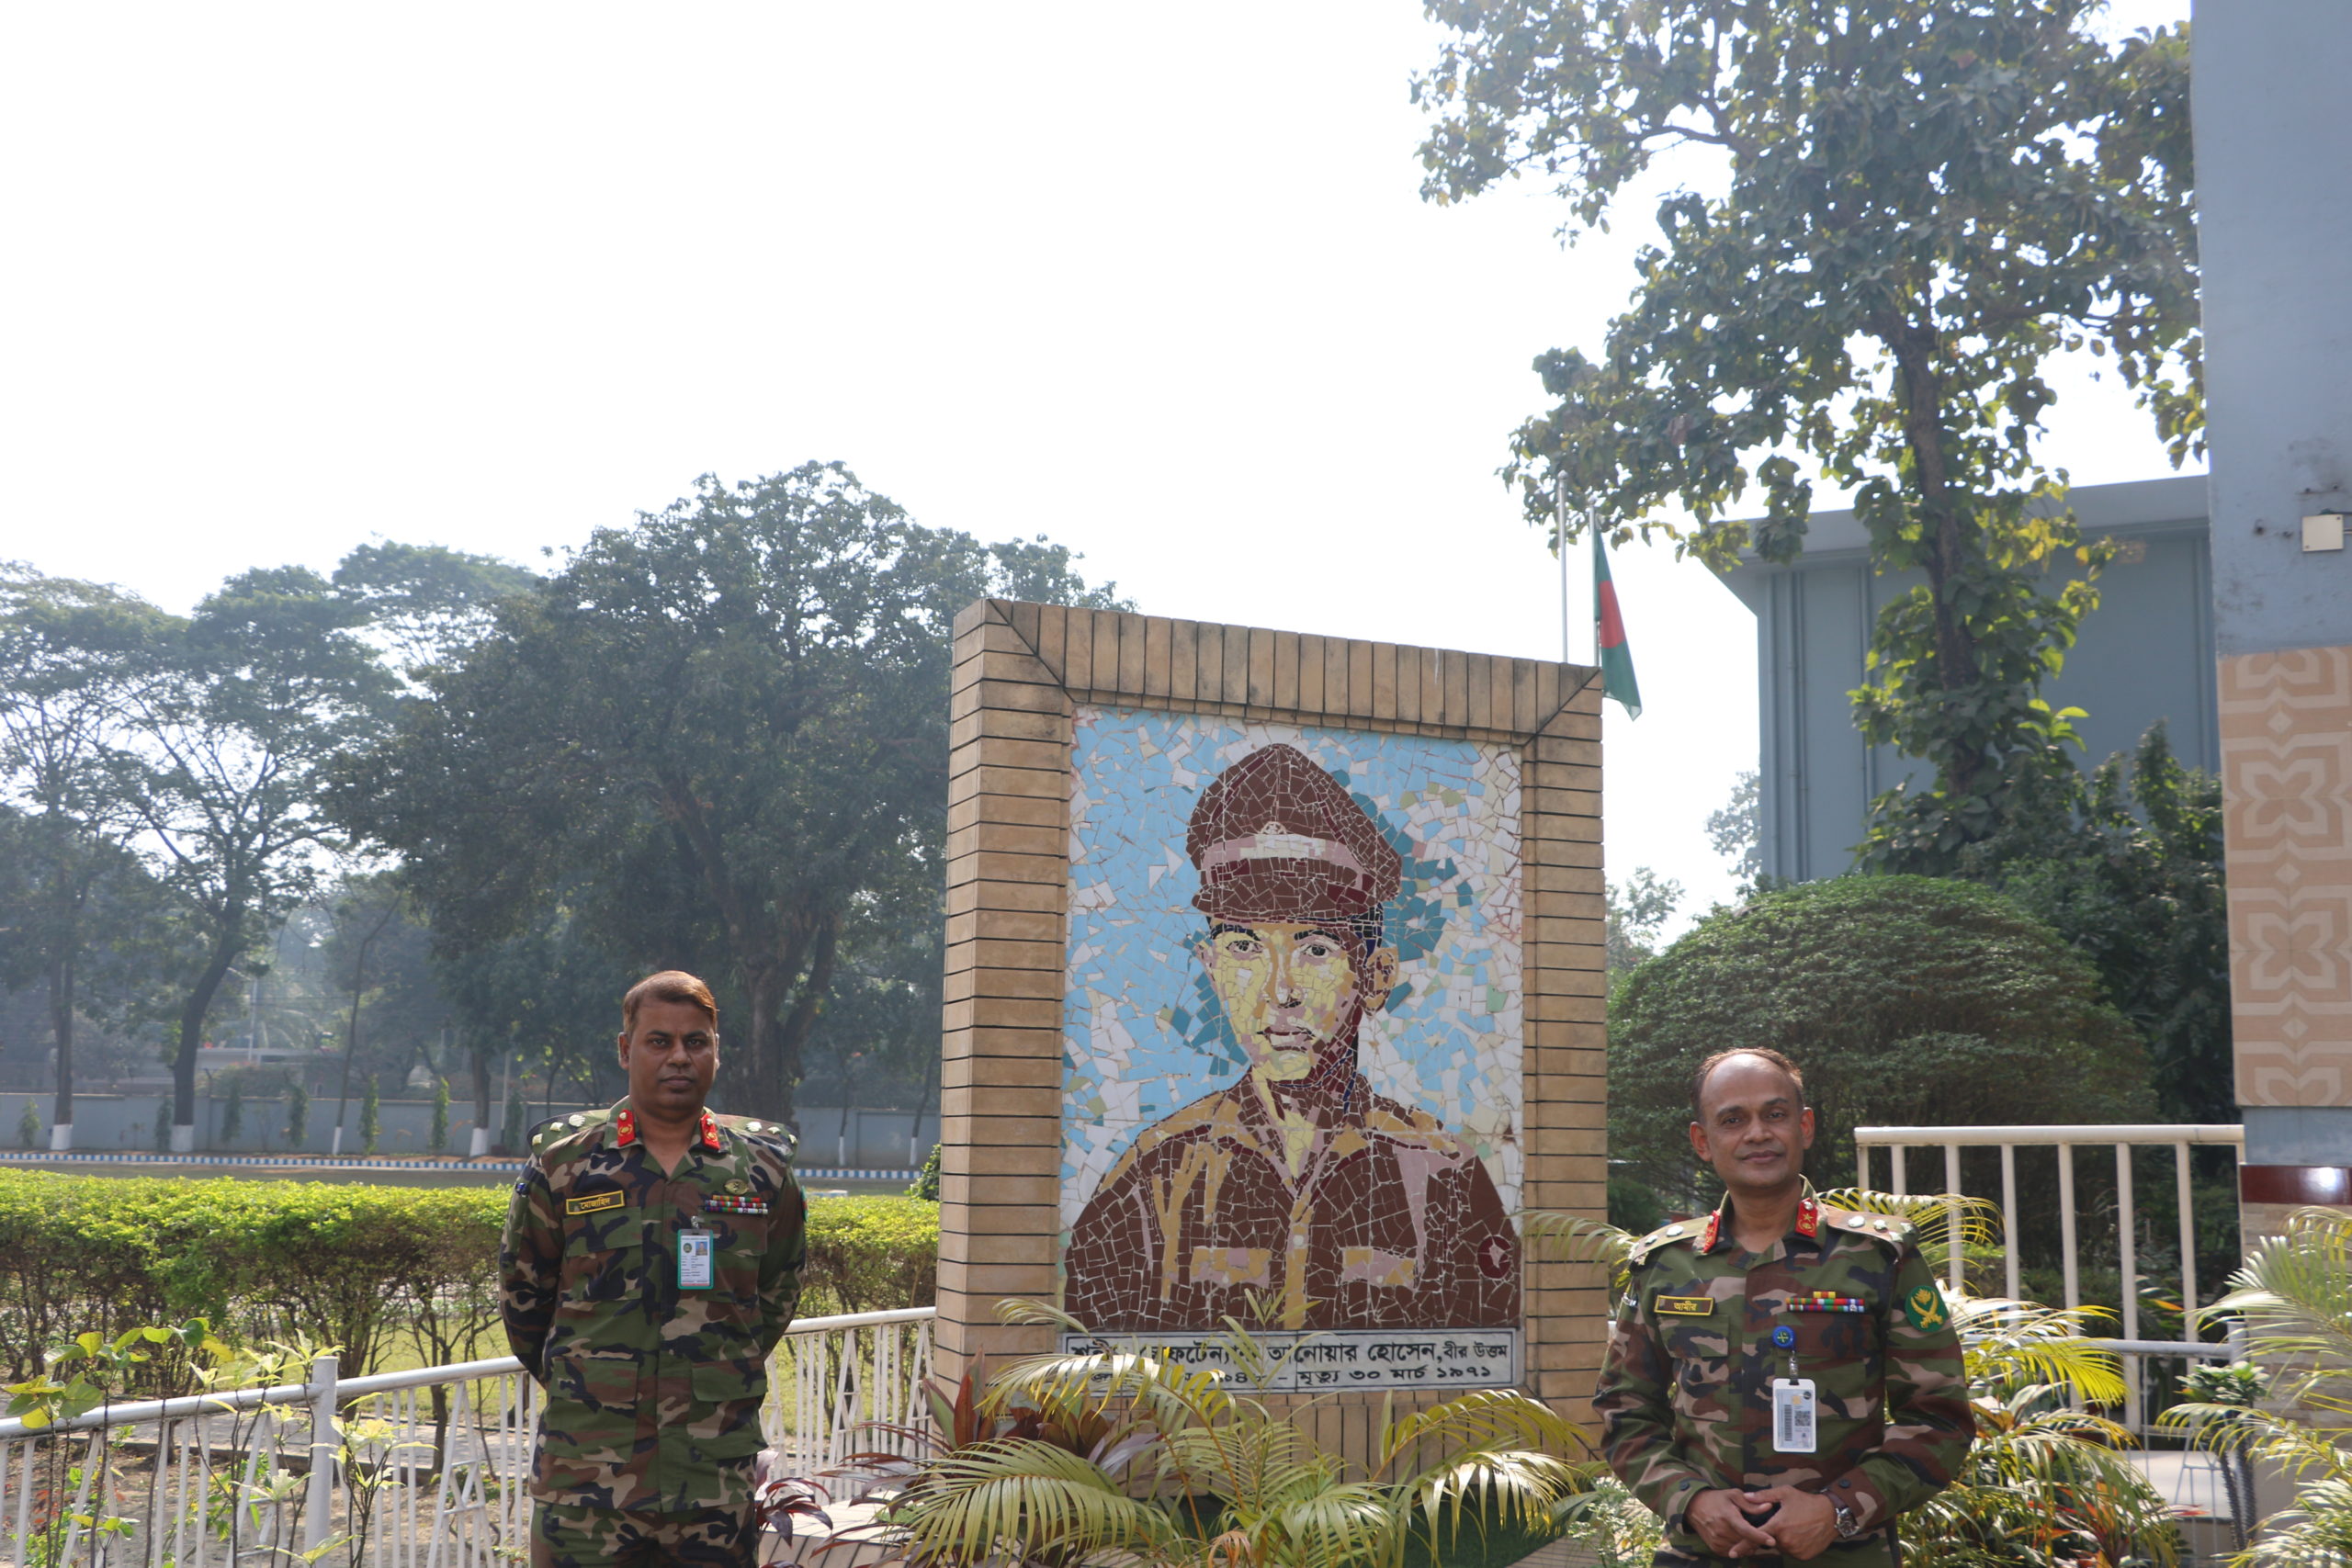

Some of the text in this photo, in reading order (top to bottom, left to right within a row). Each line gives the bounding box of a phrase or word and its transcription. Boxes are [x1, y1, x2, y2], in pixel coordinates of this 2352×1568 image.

[1267, 1343, 1359, 1364] আনোয়ার
[1442, 1340, 1468, 1359] বীর
[1349, 1371, 1381, 1381] ৩০
[1389, 1364, 1429, 1381] মার্চ
[1436, 1365, 1492, 1379] ১৯৭১
